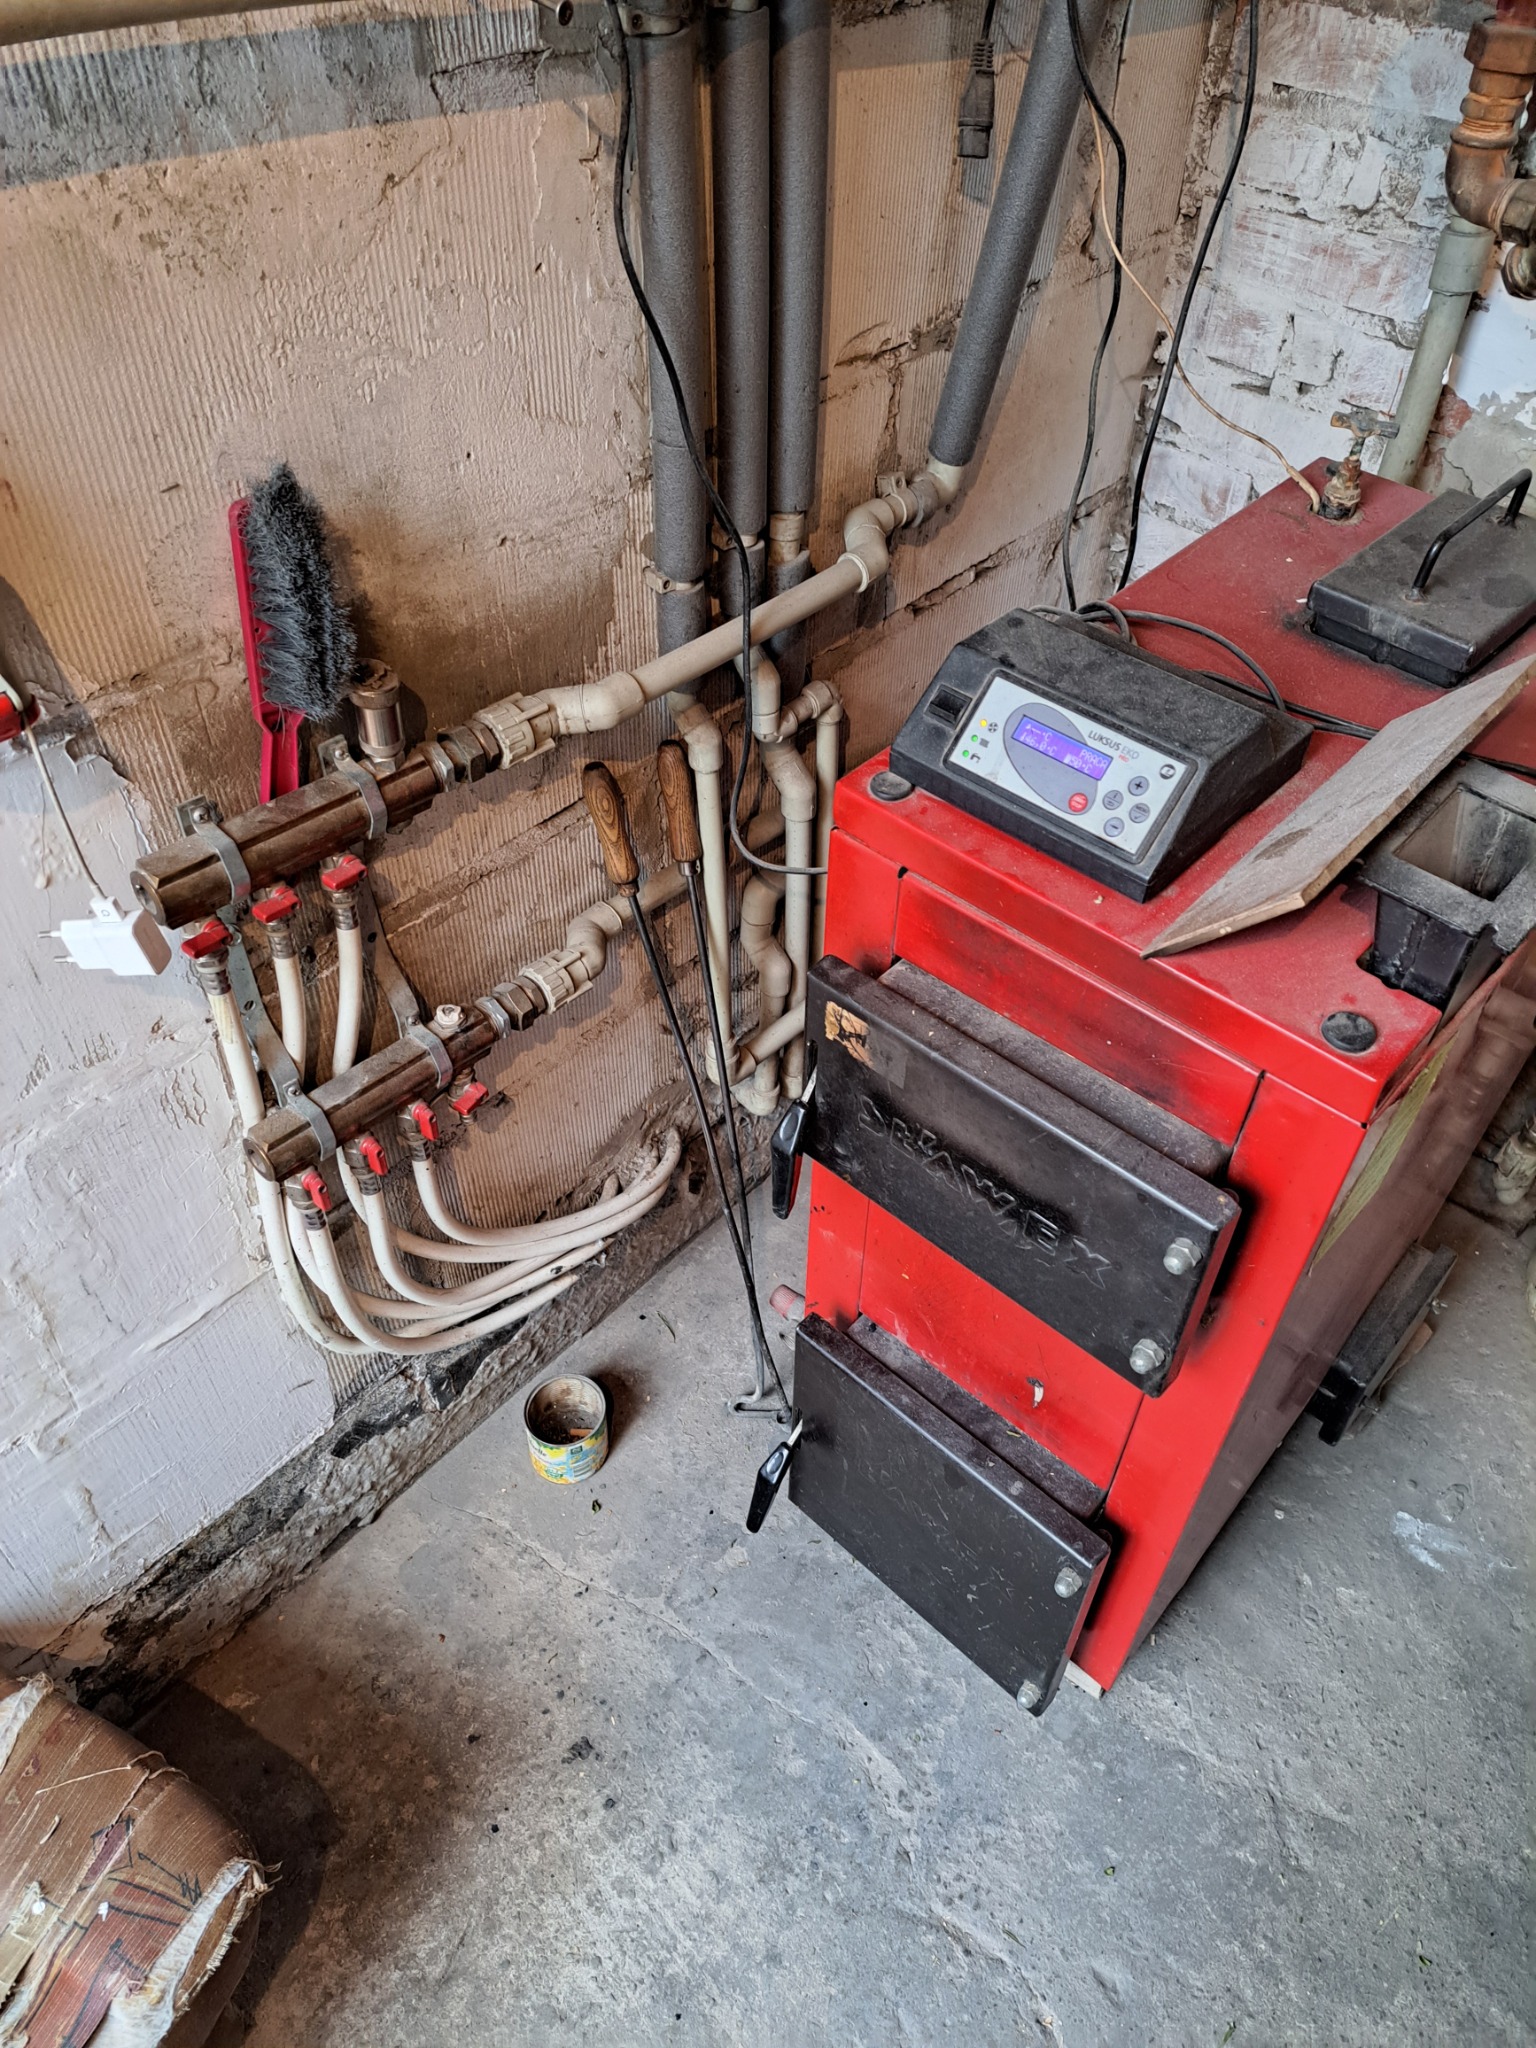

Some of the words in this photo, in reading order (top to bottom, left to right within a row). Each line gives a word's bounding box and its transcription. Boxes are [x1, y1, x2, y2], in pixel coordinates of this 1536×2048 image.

[1088, 730, 1122, 751] LUKSUS
[1121, 745, 1140, 760] EKO
[1079, 749, 1109, 769] PRACA
